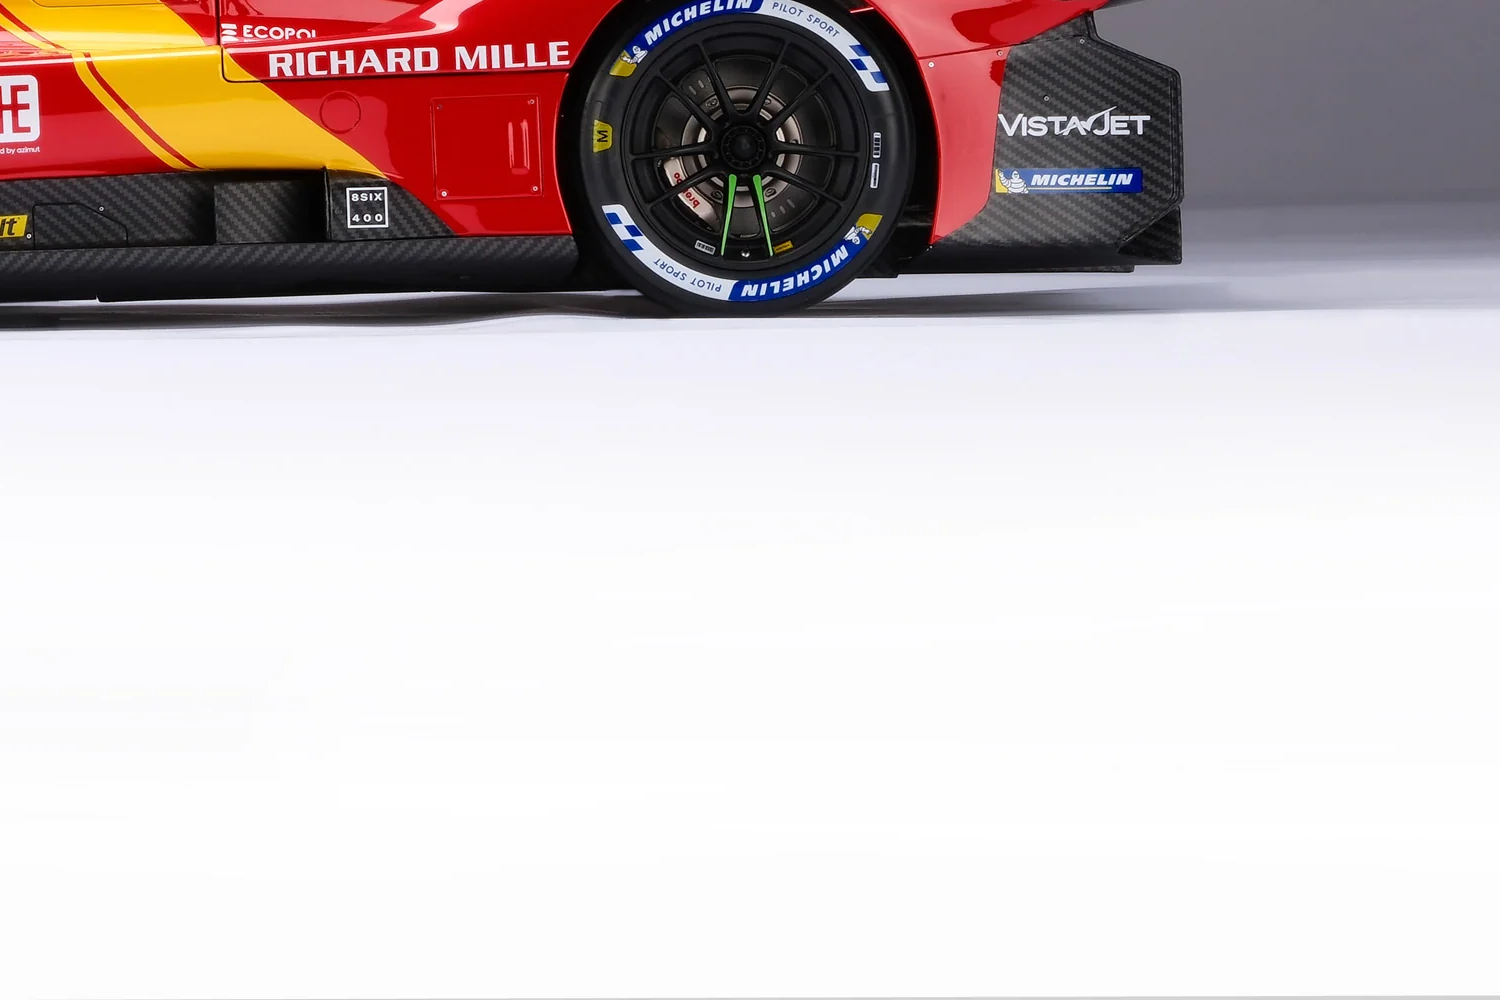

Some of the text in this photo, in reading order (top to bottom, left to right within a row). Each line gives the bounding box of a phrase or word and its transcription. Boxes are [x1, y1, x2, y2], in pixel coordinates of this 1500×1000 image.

[771, 1, 804, 18] PILOT
[806, 14, 841, 39] SPORT
[268, 41, 571, 78] RICHARD MILLE
[596, 129, 608, 143] M
[5, 147, 16, 155] by
[16, 146, 41, 154] azimut
[1030, 173, 1134, 186] MICHELIN
[351, 192, 383, 202] 8SIX
[351, 213, 383, 223] 400
[653, 258, 688, 285] SPORT
[741, 244, 850, 297] MICHELIN
[689, 278, 722, 293] PILOT
